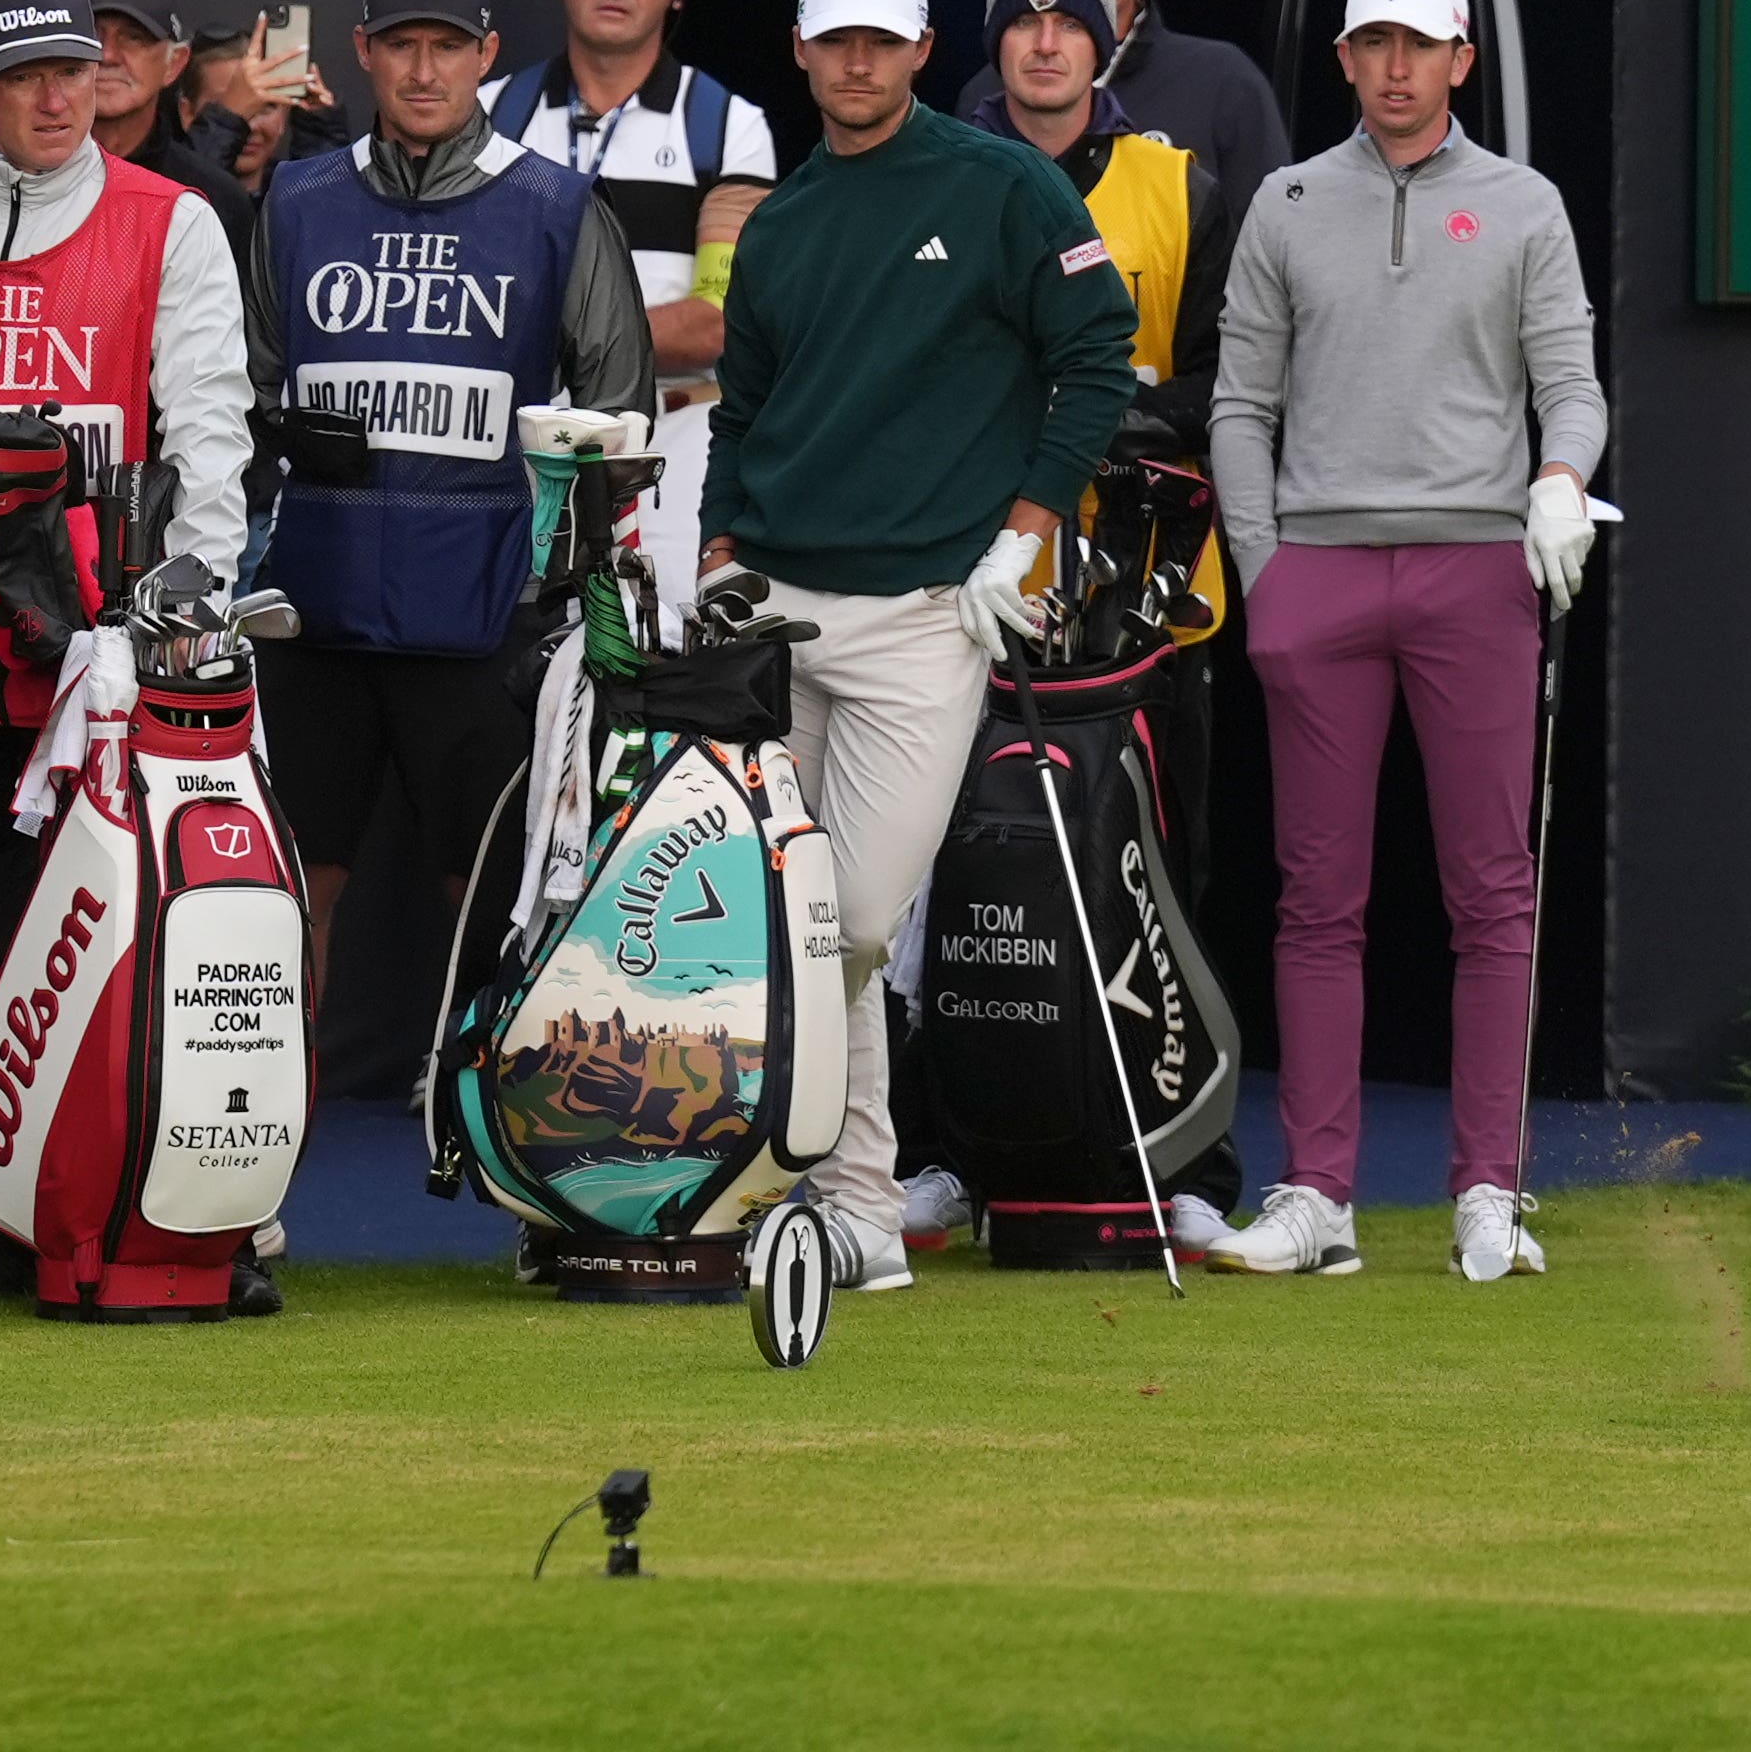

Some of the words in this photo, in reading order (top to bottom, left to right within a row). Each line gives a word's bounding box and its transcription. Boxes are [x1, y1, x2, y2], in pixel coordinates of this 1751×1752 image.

[372, 232, 460, 270] THE
[306, 261, 515, 339] OPEN
[462, 386, 494, 443] N.
[176, 775, 237, 793] Wilson
[615, 803, 729, 978] Callaway
[968, 903, 1024, 933] TOM
[941, 934, 1057, 966] MCKIBBIN
[197, 962, 283, 985] PADRAIG
[1120, 839, 1186, 1102] Callaway
[174, 986, 295, 1009] HARRINGTON
[209, 1012, 262, 1033] .COM
[184, 1037, 285, 1054] #paddysgolftips
[168, 1123, 292, 1150] SETANTA
[198, 1154, 260, 1169] College
